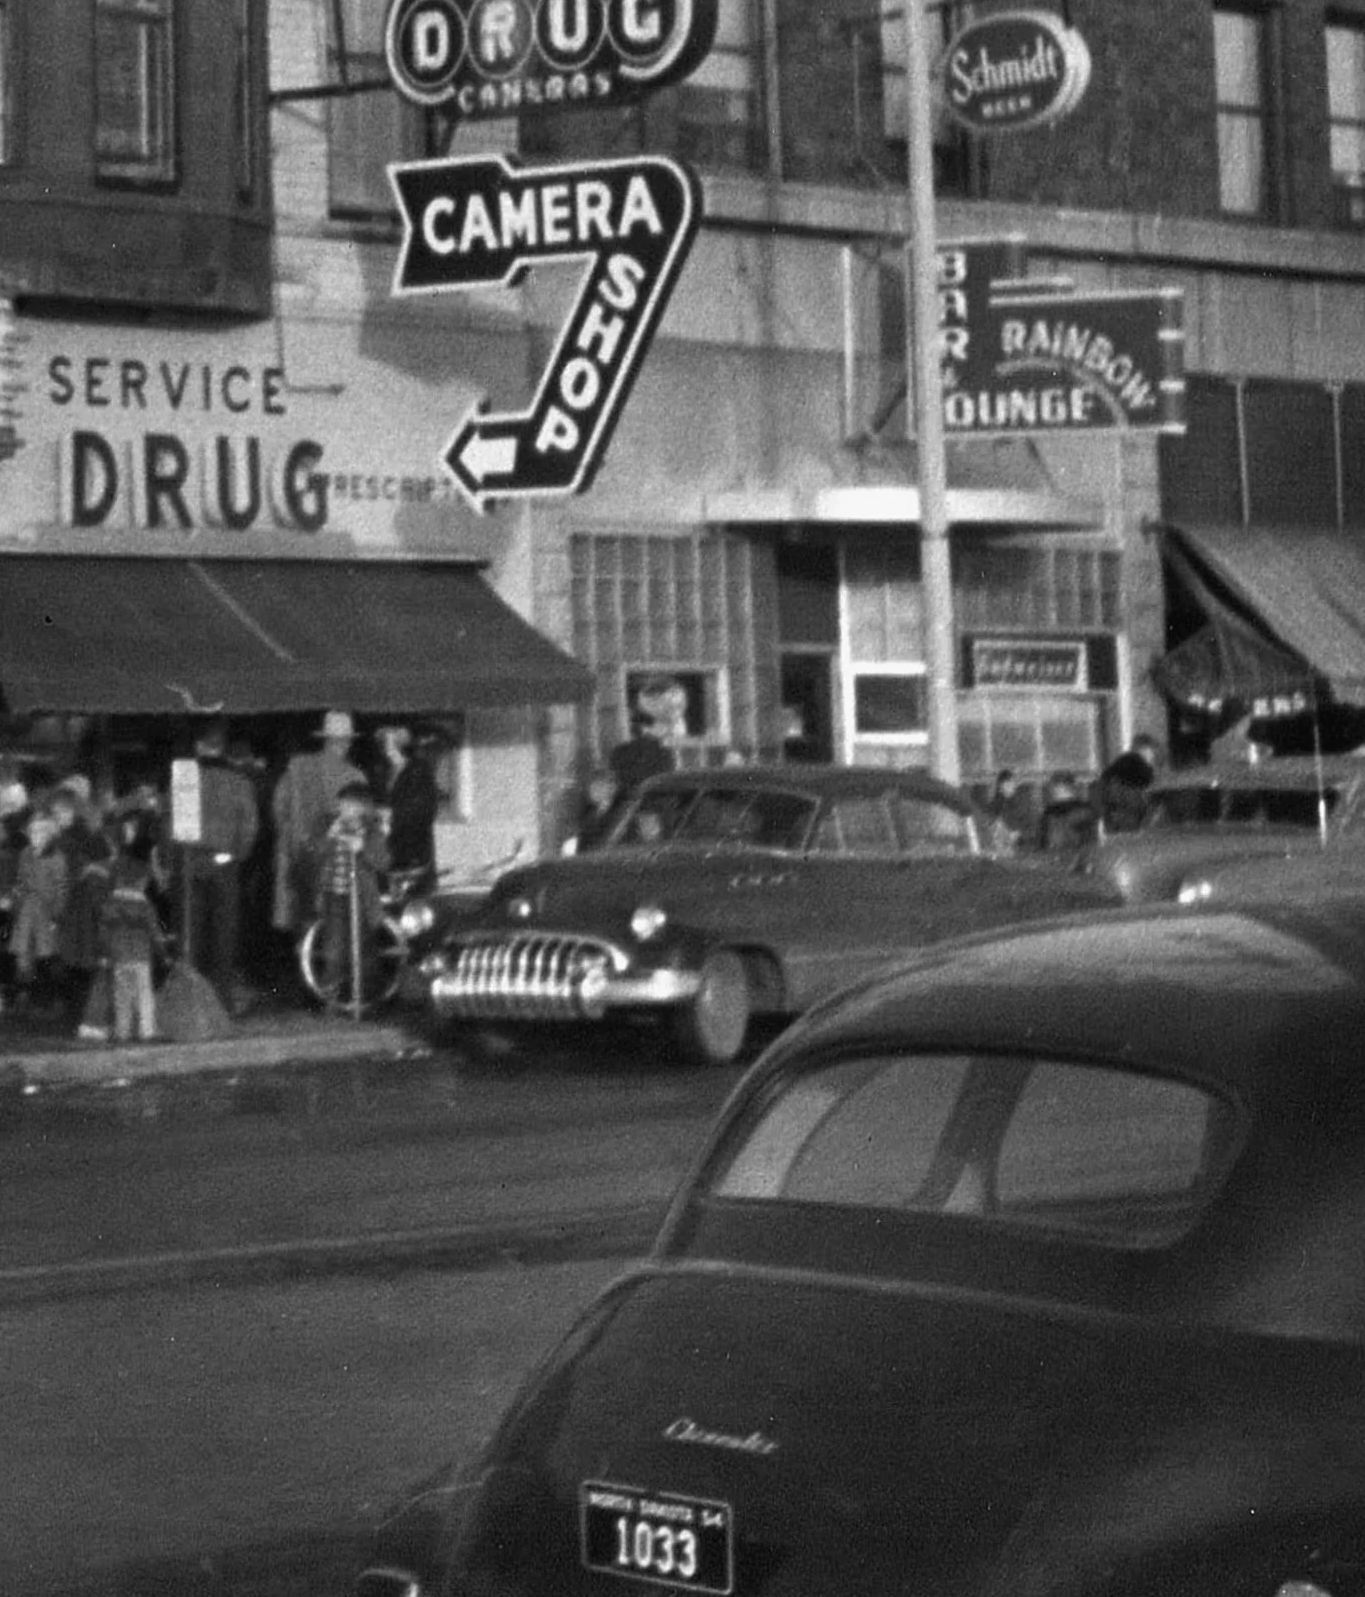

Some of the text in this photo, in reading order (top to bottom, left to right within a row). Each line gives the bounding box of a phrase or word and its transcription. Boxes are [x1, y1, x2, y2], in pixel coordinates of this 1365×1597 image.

[950, 34, 1059, 104] Schmidt
[422, 176, 664, 254] CAMERA
[48, 355, 287, 415] SERVICE
[535, 253, 645, 454] SHOP
[1001, 320, 1156, 409] RAINBOW
[943, 387, 1092, 426] OUNGE
[72, 430, 329, 531] DRUG
[618, 1517, 697, 1578] 1033
